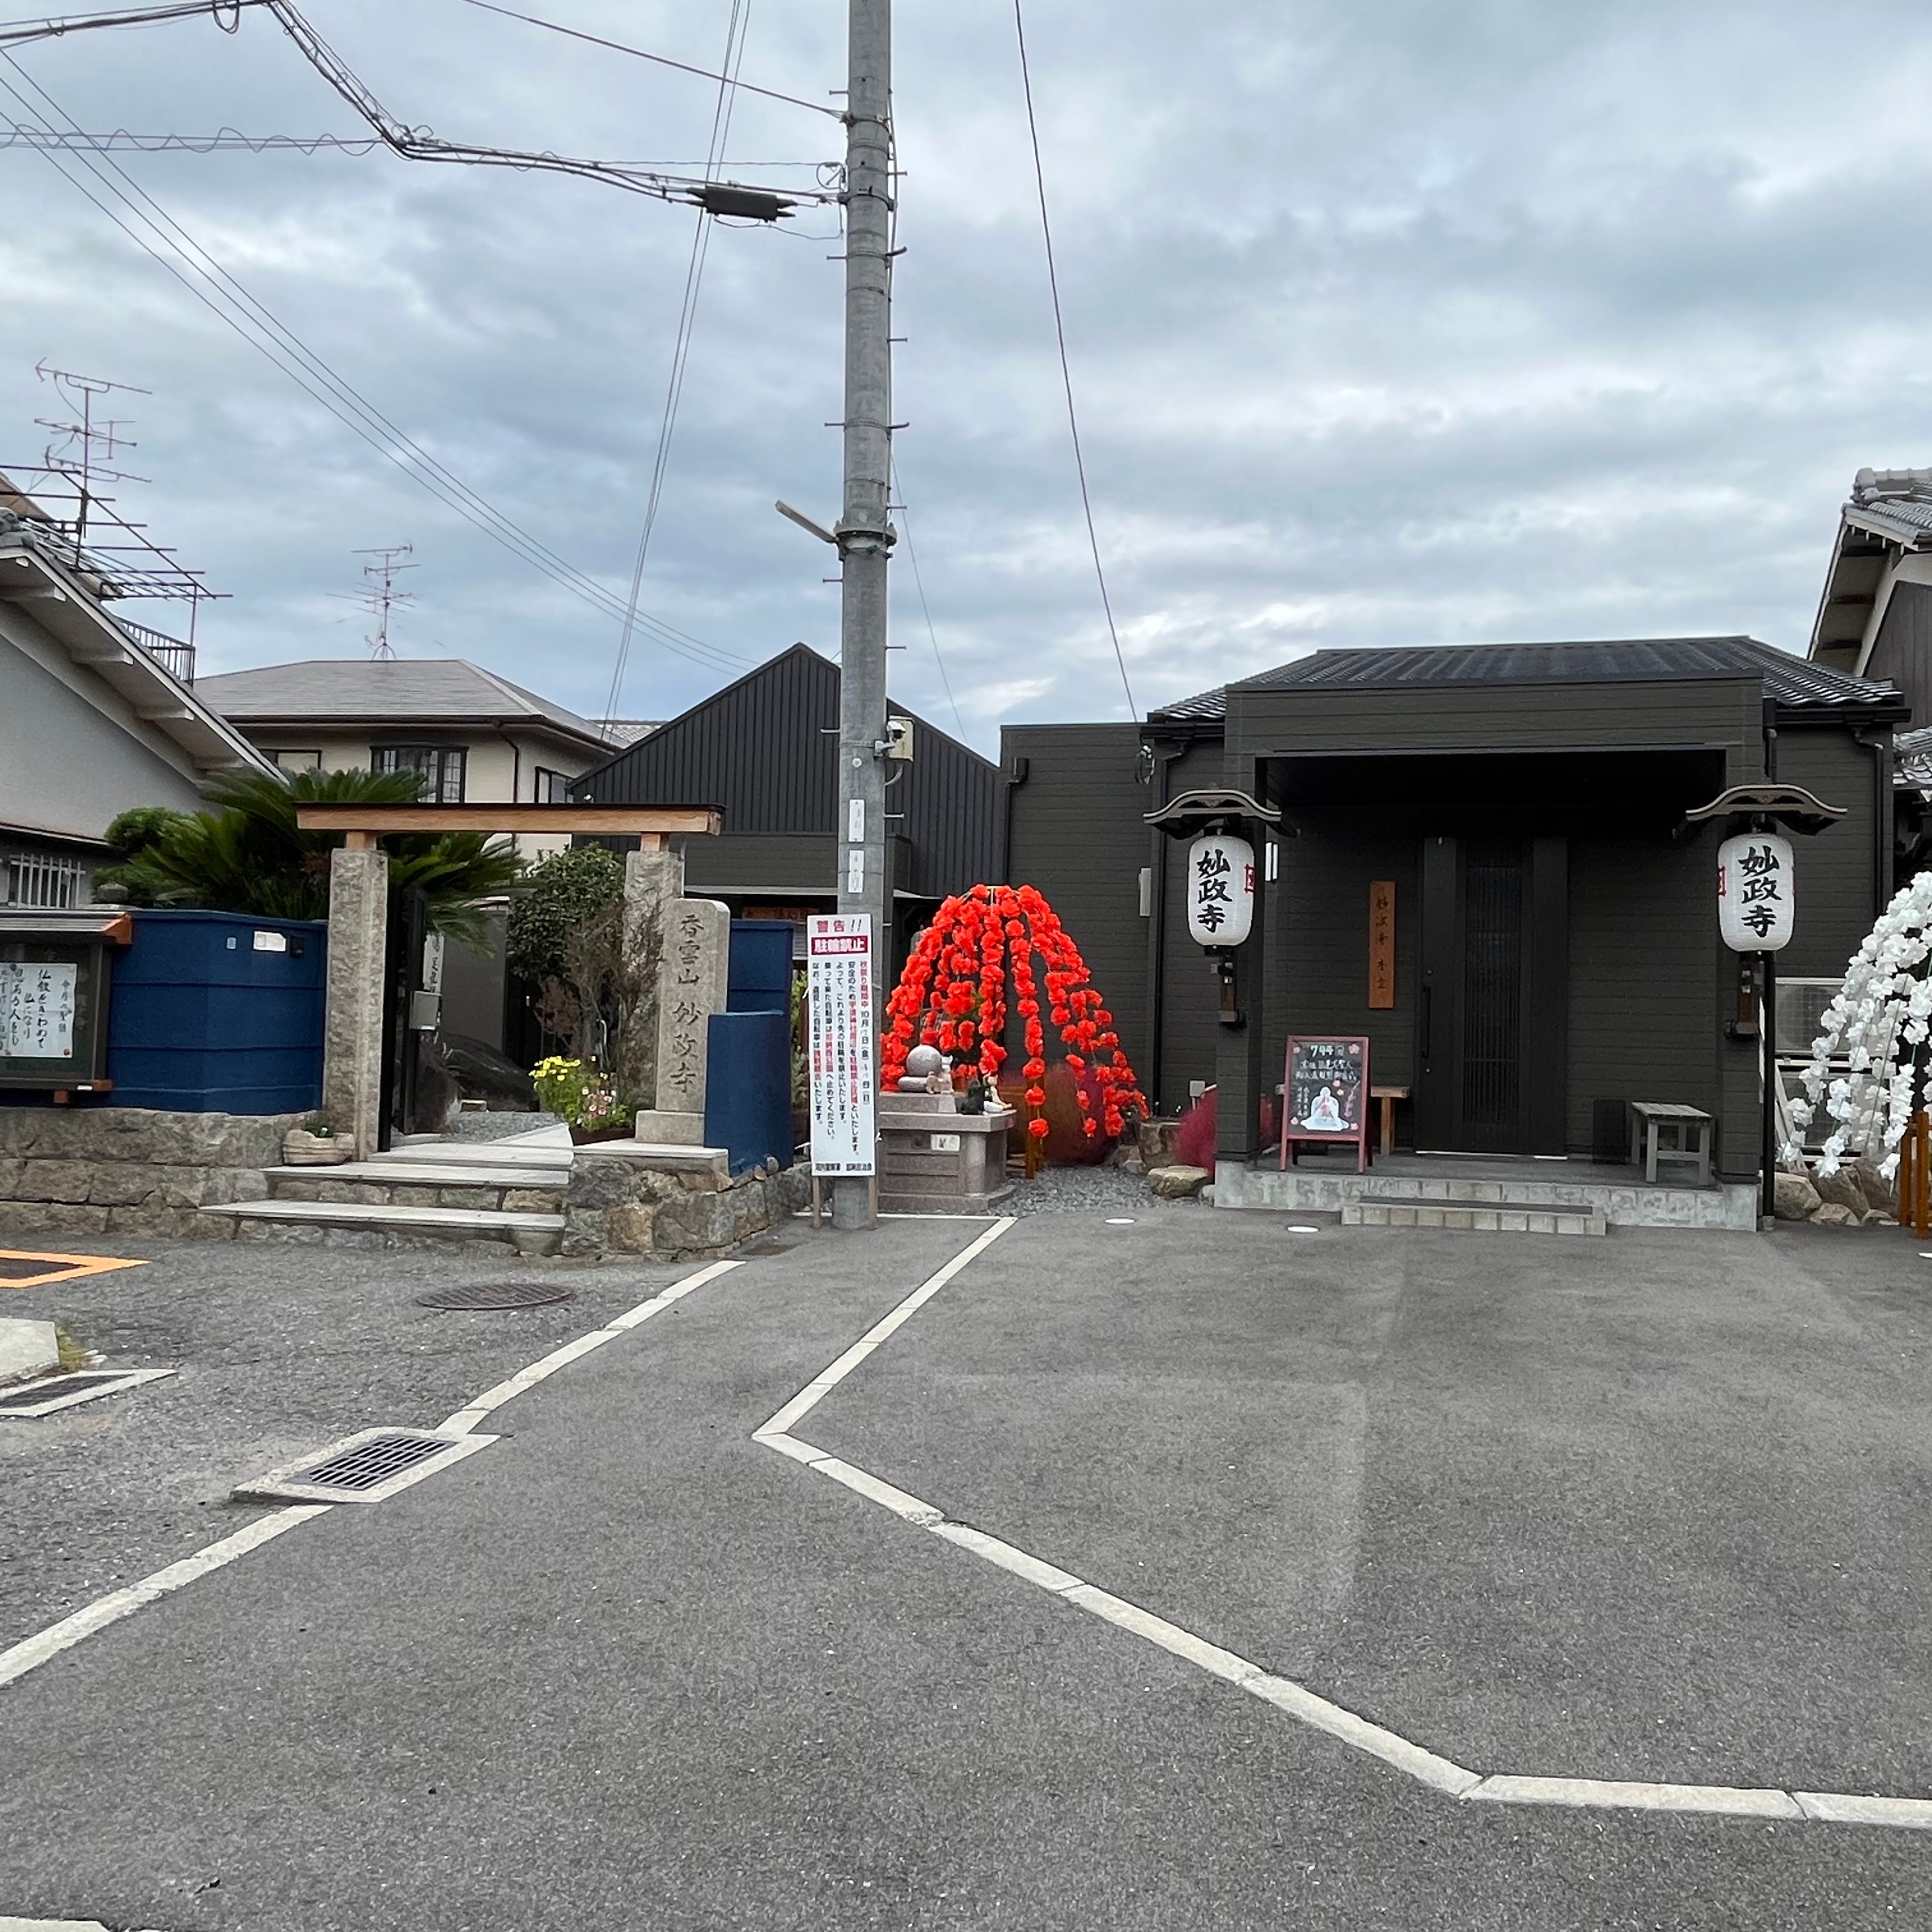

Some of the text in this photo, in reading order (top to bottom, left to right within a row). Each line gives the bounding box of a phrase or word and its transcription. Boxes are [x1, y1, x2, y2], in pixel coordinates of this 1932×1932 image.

[1196, 849, 1233, 933] 妙政寺
[1738, 845, 1782, 937] 妙政寺
